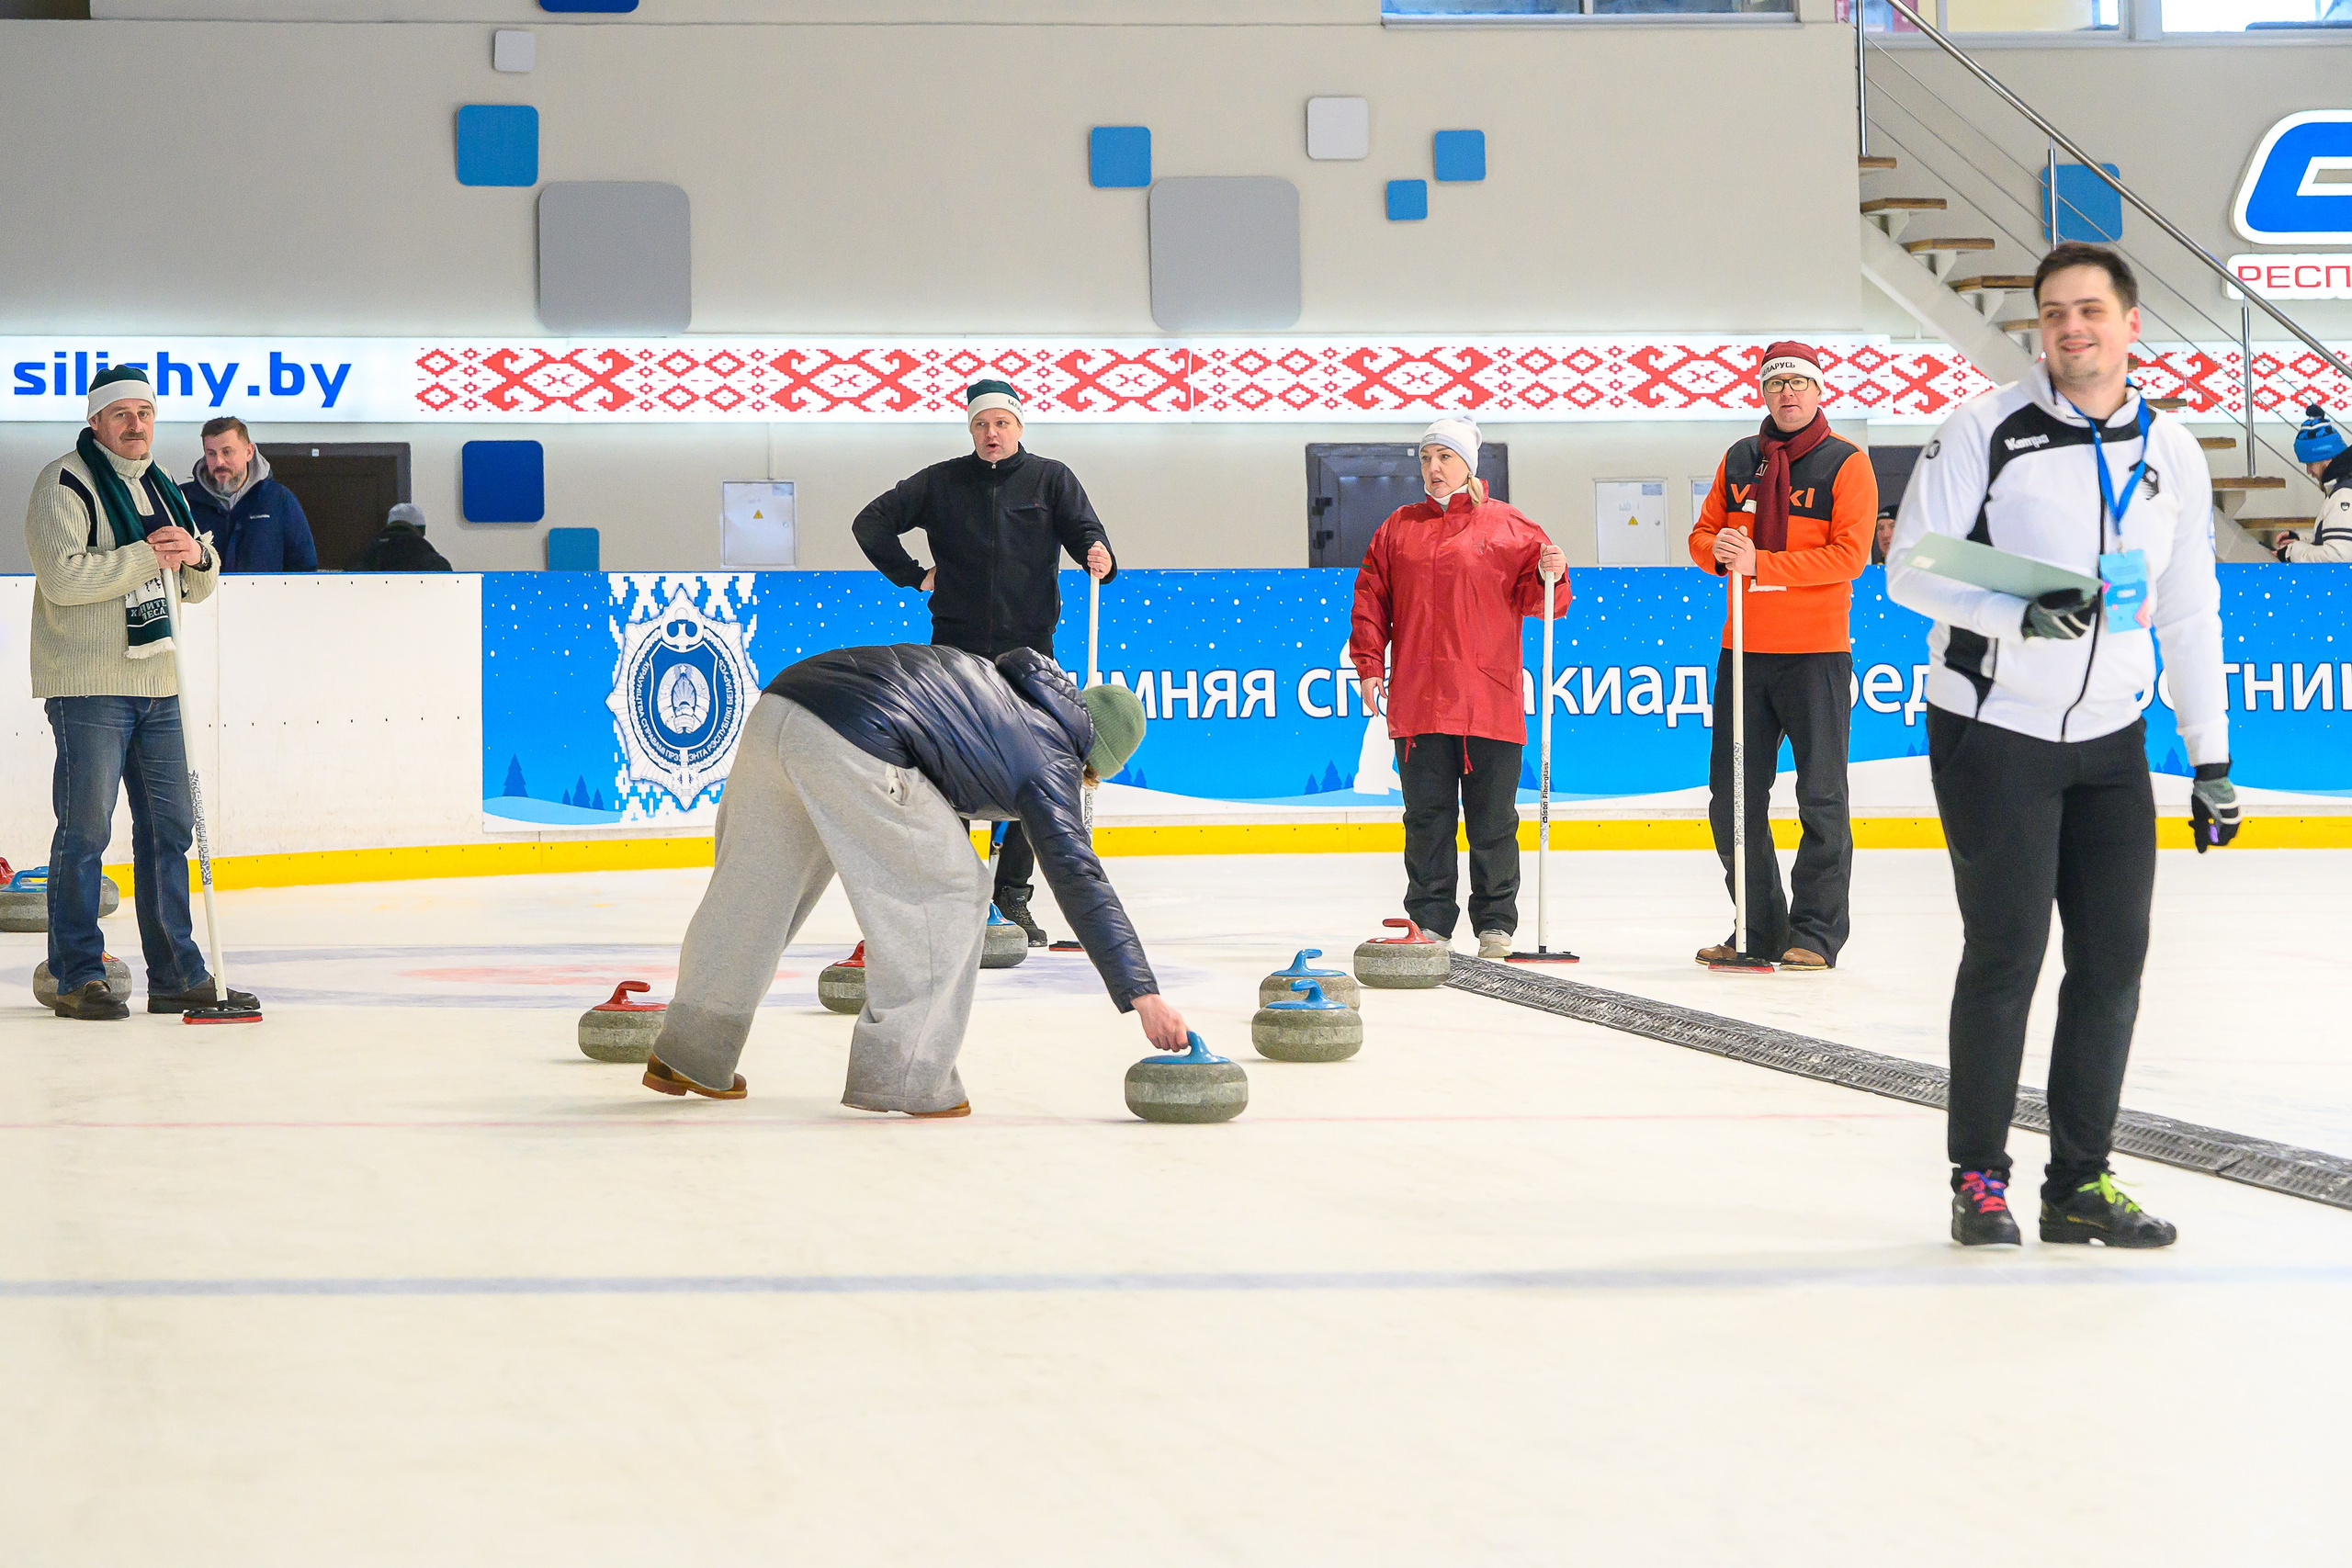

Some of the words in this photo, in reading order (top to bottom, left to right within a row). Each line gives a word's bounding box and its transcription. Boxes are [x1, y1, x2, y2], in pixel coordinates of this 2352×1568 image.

[2237, 265, 2351, 288] РЕСП
[14, 351, 352, 409] silhy.by
[2004, 434, 2050, 451] Kempa
[718, 659, 734, 705] БЕЛАРУСЬ
